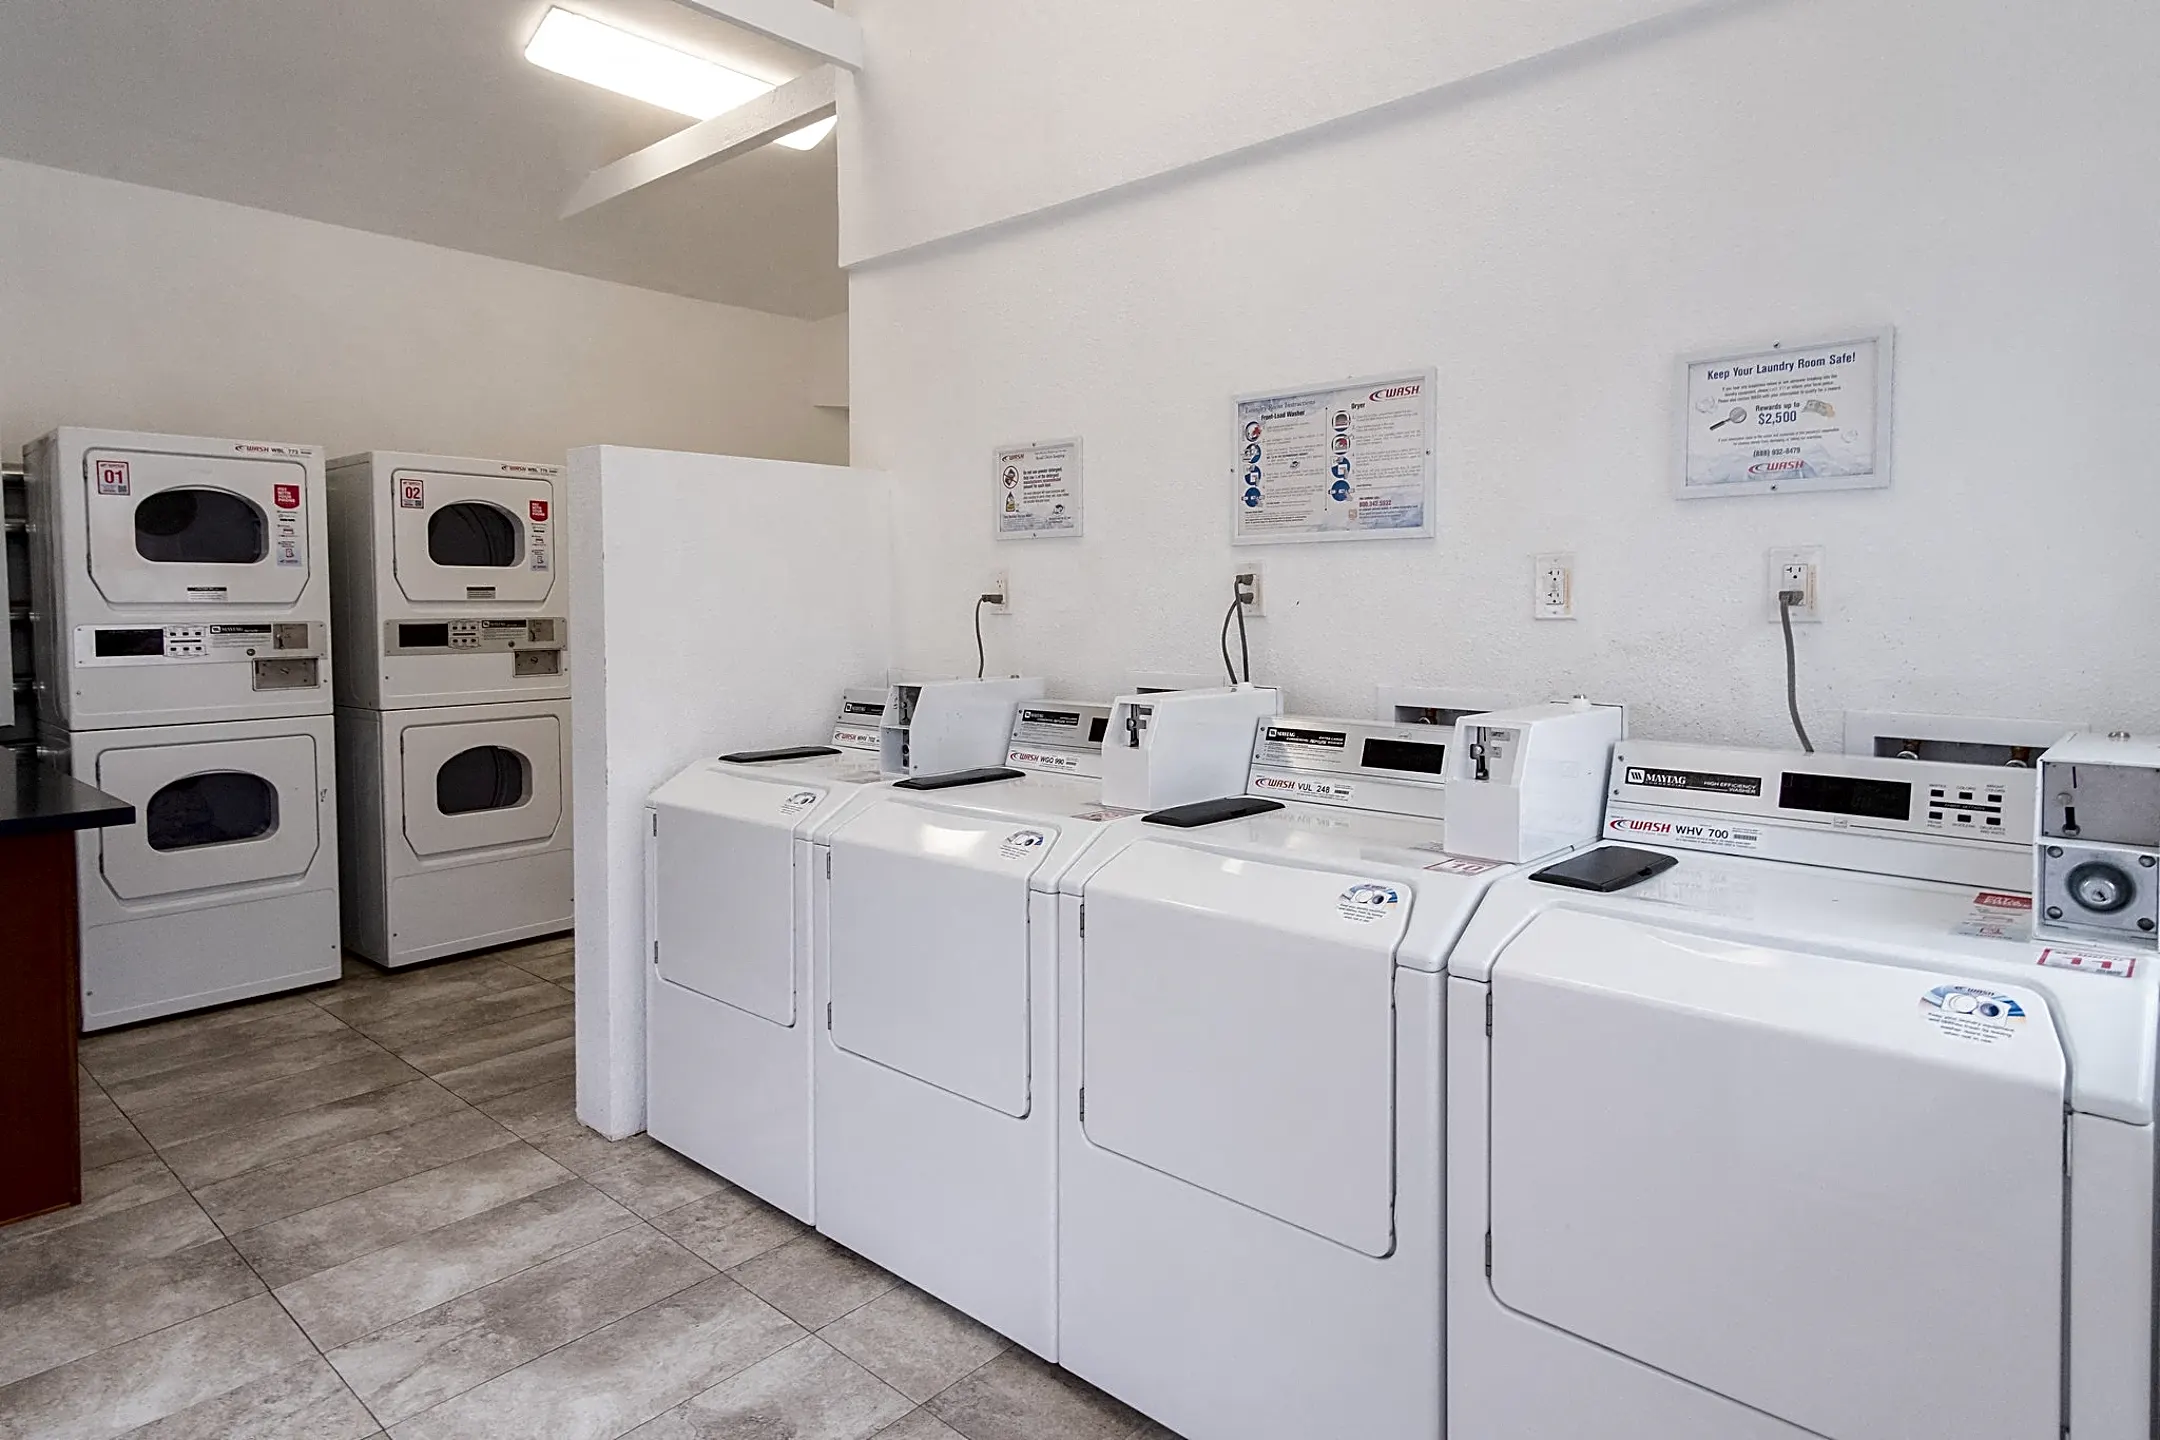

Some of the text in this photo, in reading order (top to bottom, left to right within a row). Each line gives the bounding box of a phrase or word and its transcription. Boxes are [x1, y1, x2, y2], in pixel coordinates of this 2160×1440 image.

[1707, 352, 1856, 381] Keep Your Laundry Room Safe!
[1386, 386, 1420, 398] WASH
[1756, 404, 1782, 412] Rewards
[1784, 403, 1792, 411] up
[1758, 411, 1797, 426] $2,500
[1767, 460, 1805, 471] WASH
[104, 469, 123, 484] 01
[406, 487, 421, 499] 02
[1268, 779, 1296, 789] WASH
[1298, 783, 1313, 792] VUL
[1646, 774, 1687, 785] MAYTAG
[1720, 782, 1757, 790] EFFICIENCY
[1630, 821, 1729, 839] WASH WHV 700
